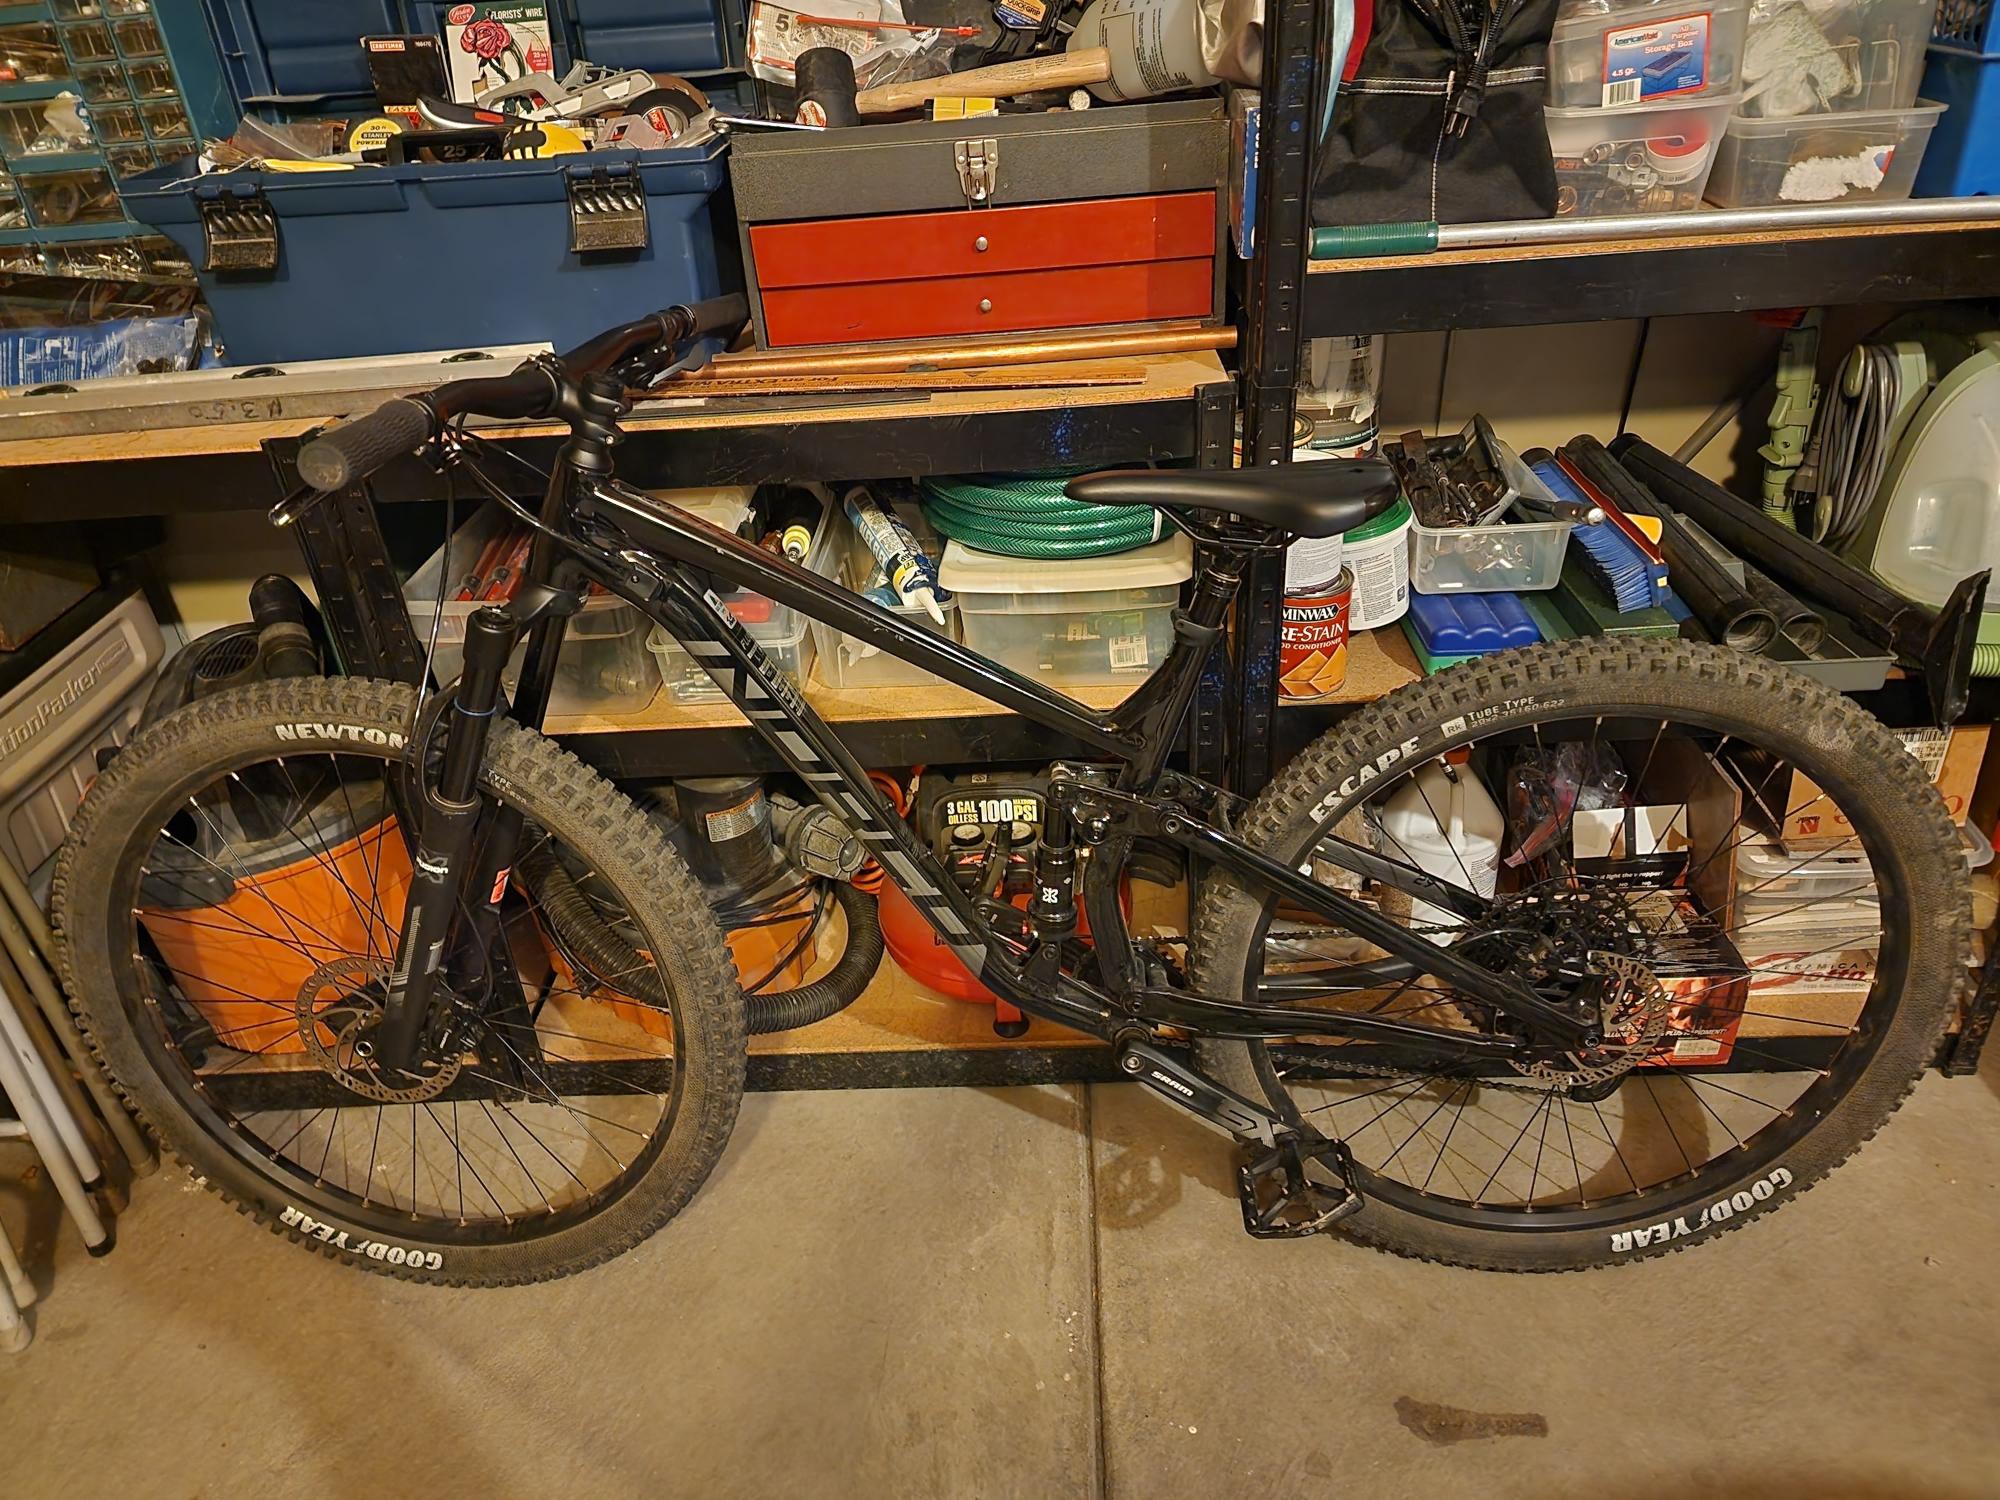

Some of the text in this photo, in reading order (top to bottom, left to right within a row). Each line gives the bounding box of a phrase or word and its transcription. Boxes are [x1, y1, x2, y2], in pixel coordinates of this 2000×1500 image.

[525, 7, 544, 18] WIRE
[775, 13, 789, 32] 5
[1644, 39, 1694, 54] Storage Box
[362, 132, 393, 140] STANLEY
[444, 145, 467, 157] 25
[1282, 606, 1335, 620] MINWAX
[1281, 620, 1344, 642] RE-STAIN
[1467, 696, 1535, 723] TUBE TYPE
[275, 723, 409, 749] NEWTON
[487, 769, 513, 788] TYPE
[1309, 736, 1420, 824] ESCAPE
[947, 799, 1037, 823] 3 GAL 100 PSI
[1150, 1071, 1194, 1097] SRAM
